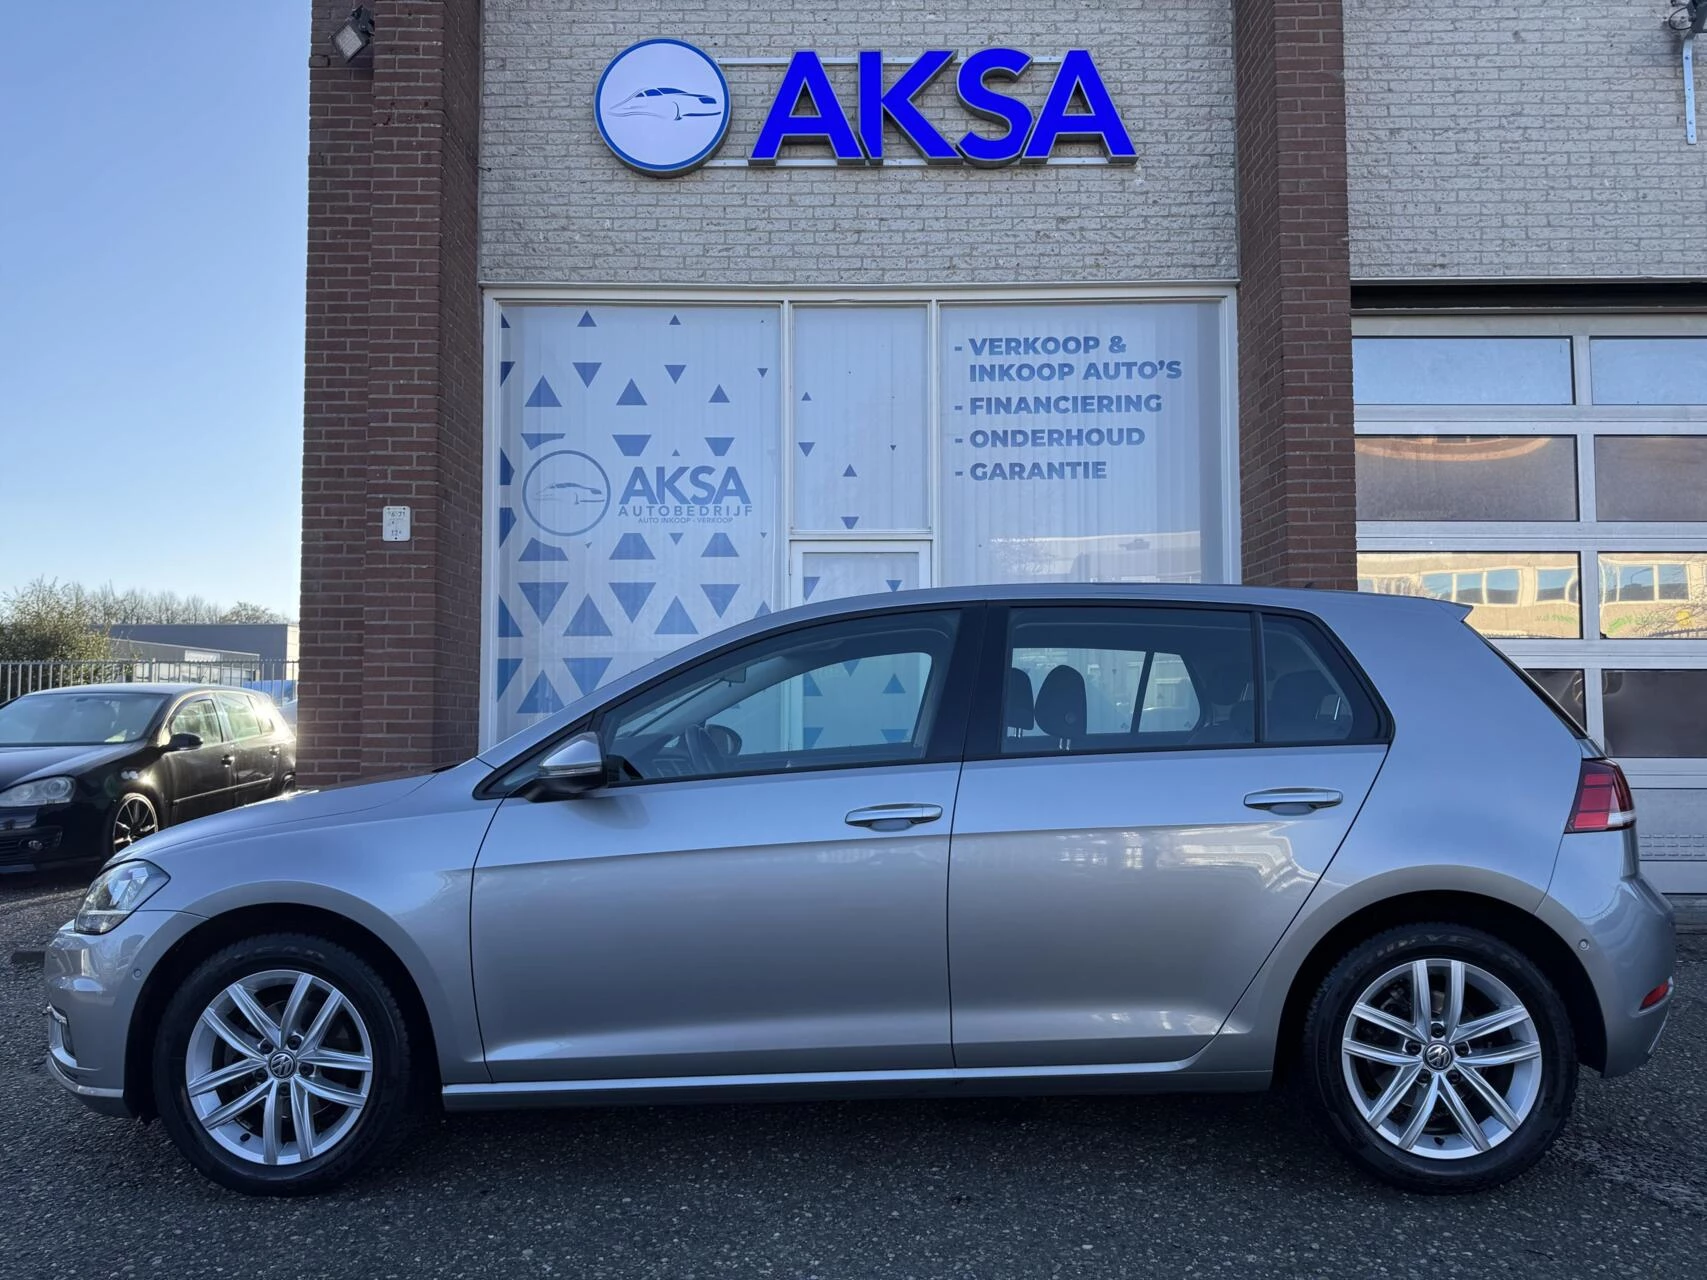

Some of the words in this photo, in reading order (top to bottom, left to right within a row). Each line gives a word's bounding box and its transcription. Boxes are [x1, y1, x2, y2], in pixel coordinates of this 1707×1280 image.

[748, 47, 1139, 169] AKSA
[968, 336, 1100, 356] VERKOOP
[1108, 335, 1127, 354] &
[969, 362, 1075, 382] INKOOP
[969, 393, 1163, 415] FINANCIERING
[969, 427, 1146, 449] ONDERHOUD
[969, 460, 1107, 482] GARANTIE
[618, 465, 752, 505] AKSA
[618, 505, 753, 517] AUTOBEDRIJF
